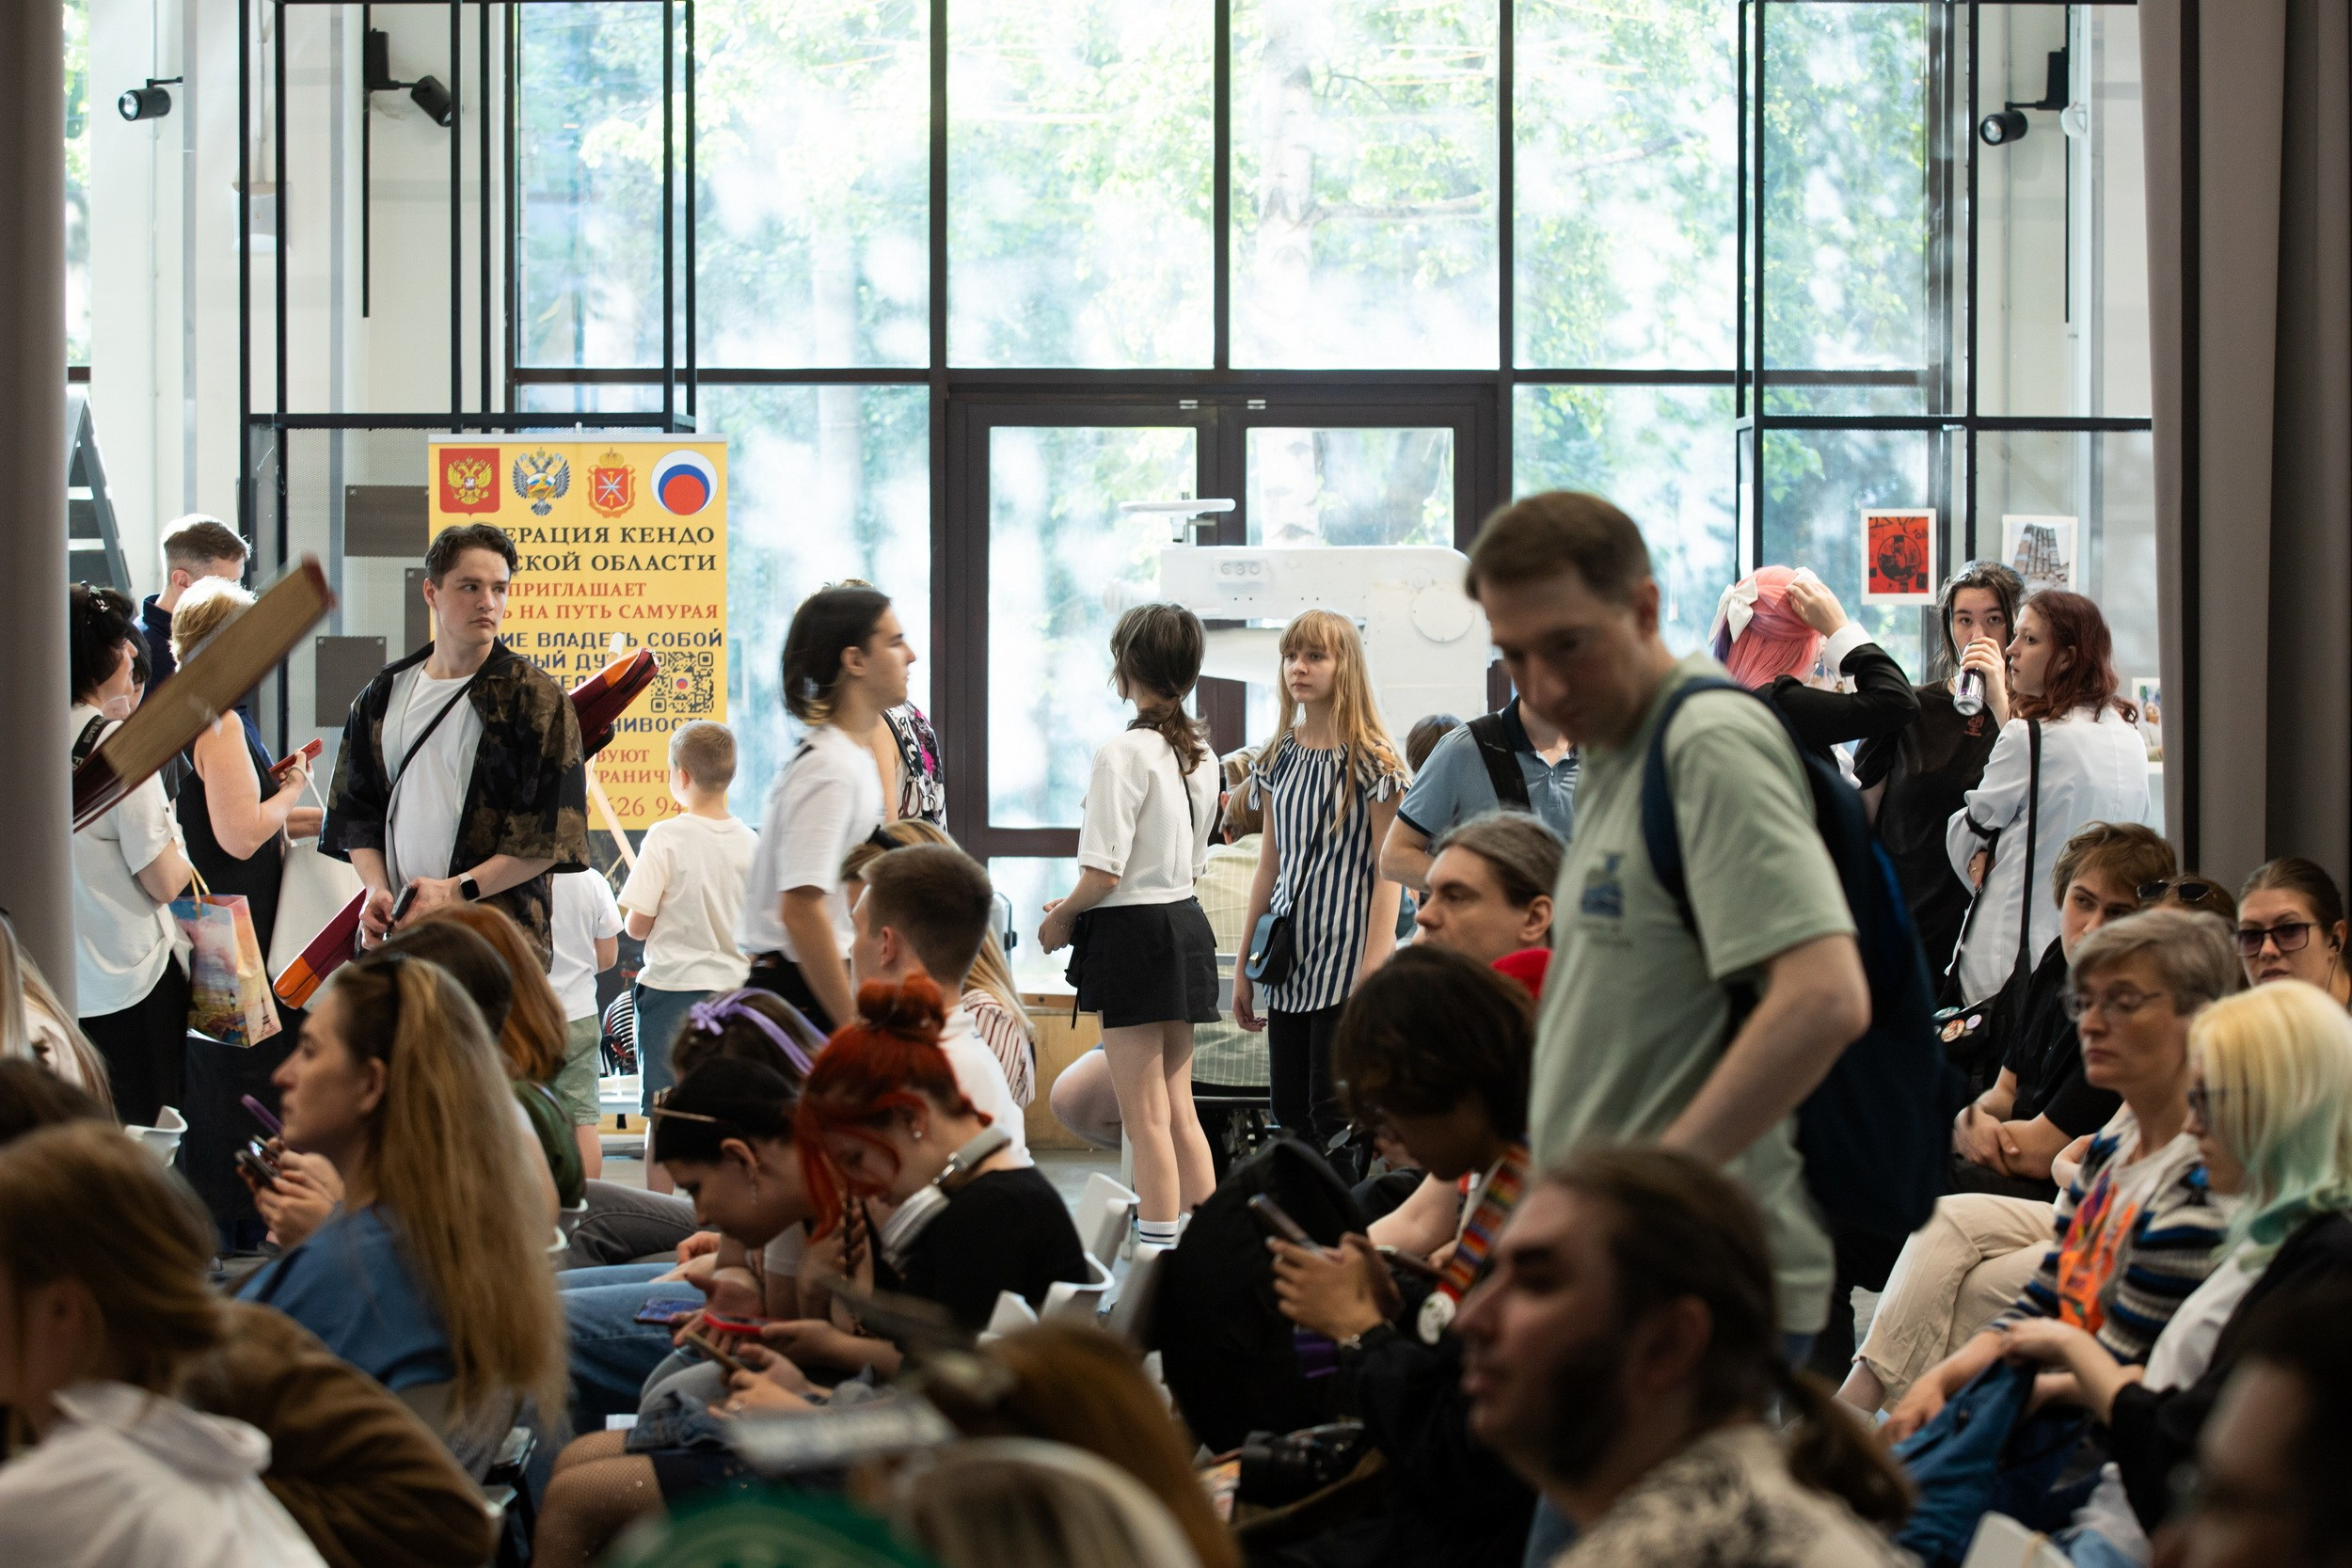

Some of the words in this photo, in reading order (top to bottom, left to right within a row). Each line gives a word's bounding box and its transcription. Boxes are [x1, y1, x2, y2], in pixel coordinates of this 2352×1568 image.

[501, 527, 610, 546] ЕРАЦИЯ
[620, 527, 715, 546] КЕНДО
[591, 554, 717, 571] ОБЛАСТИ
[507, 582, 646, 597] ПРИГЛАШАЕТ
[519, 605, 548, 620] НА
[557, 605, 612, 621] ПУТЬ
[618, 604, 718, 620] САМУРАЯ
[498, 632, 529, 647] ИЕ
[537, 632, 638, 650] ВЛАДЕЬ
[647, 628, 722, 647] СОБОЙ
[575, 653, 608, 671] ДУ
[596, 750, 649, 763] ВУЮТ
[593, 769, 671, 784] РАНИЧ
